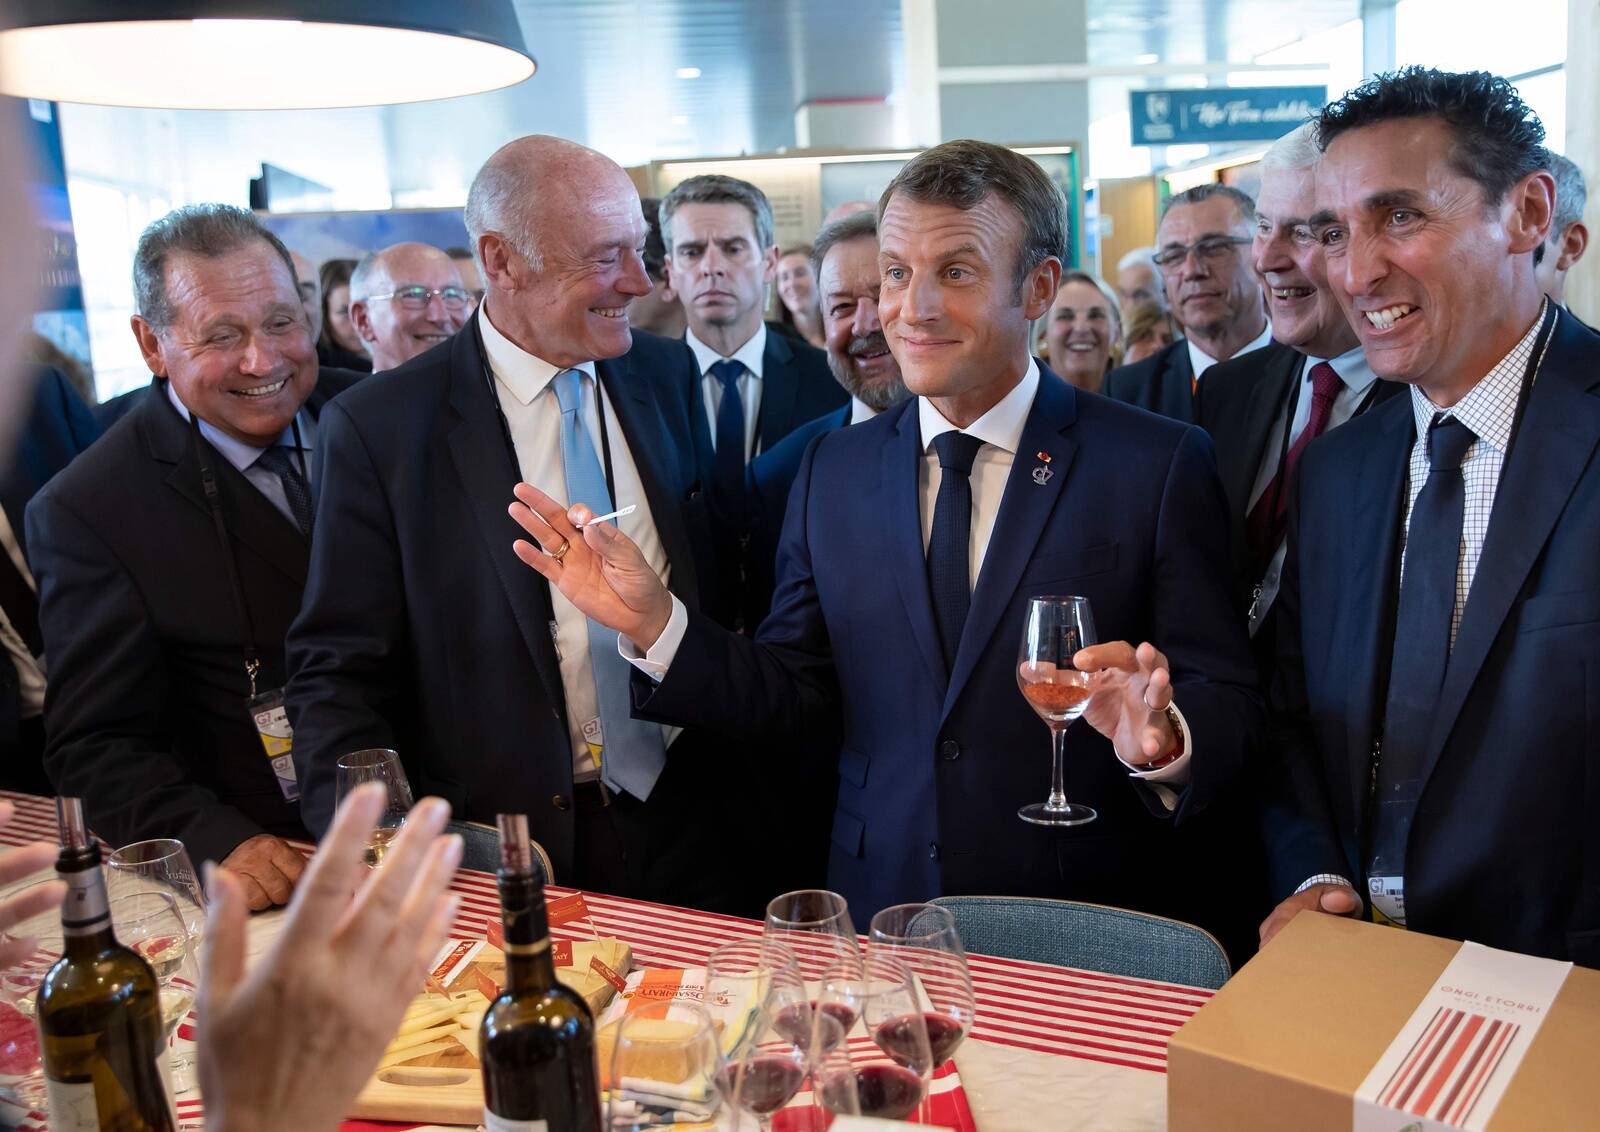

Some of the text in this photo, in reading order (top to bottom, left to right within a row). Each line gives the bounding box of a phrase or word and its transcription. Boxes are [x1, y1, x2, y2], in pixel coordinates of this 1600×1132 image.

[256, 712, 271, 725] G7
[583, 719, 598, 734] G7
[273, 756, 288, 770] G7
[1370, 878, 1384, 893] G7
[1440, 986, 1479, 999] ONGI
[1485, 995, 1541, 1013] ETORRI
